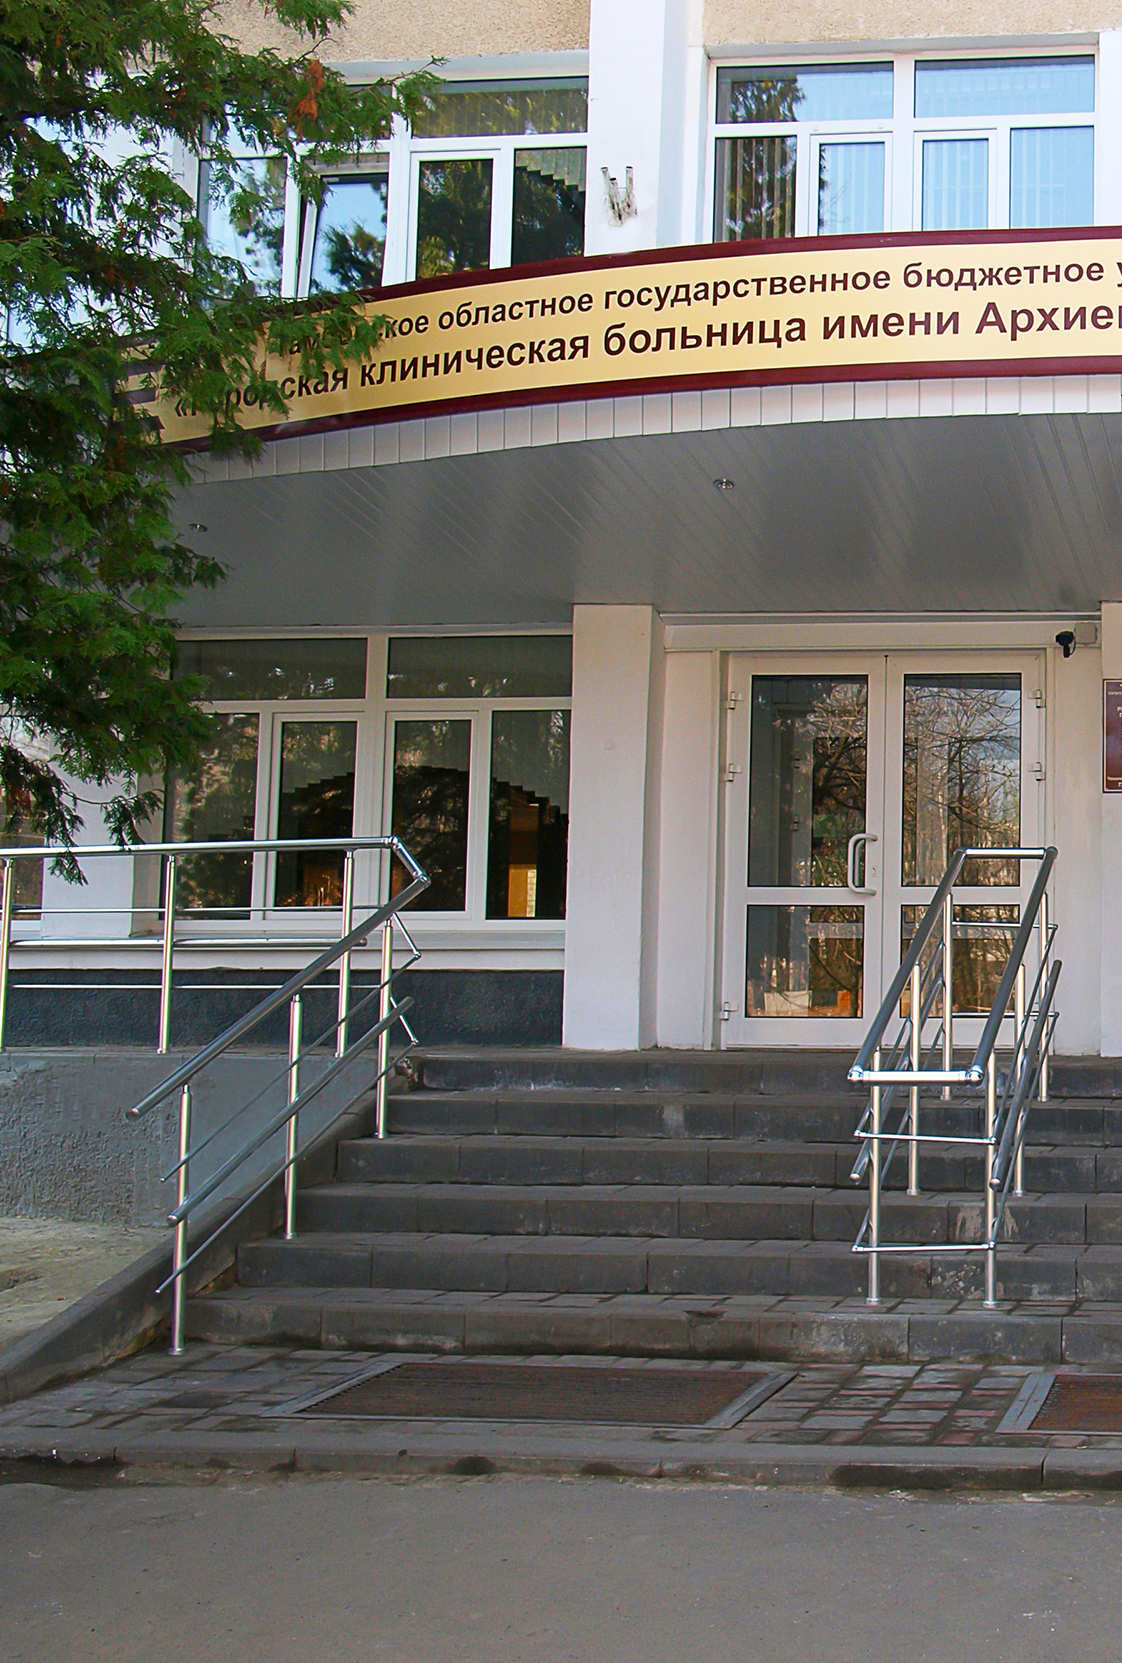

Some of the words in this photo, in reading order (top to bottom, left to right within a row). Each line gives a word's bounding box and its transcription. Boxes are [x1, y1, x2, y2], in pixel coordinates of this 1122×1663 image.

[437, 290, 594, 331] областное
[604, 269, 891, 312] государственное
[903, 262, 1105, 291] бюджетное
[360, 333, 590, 388] клиническая
[604, 311, 806, 356] больница
[823, 309, 960, 340] имени
